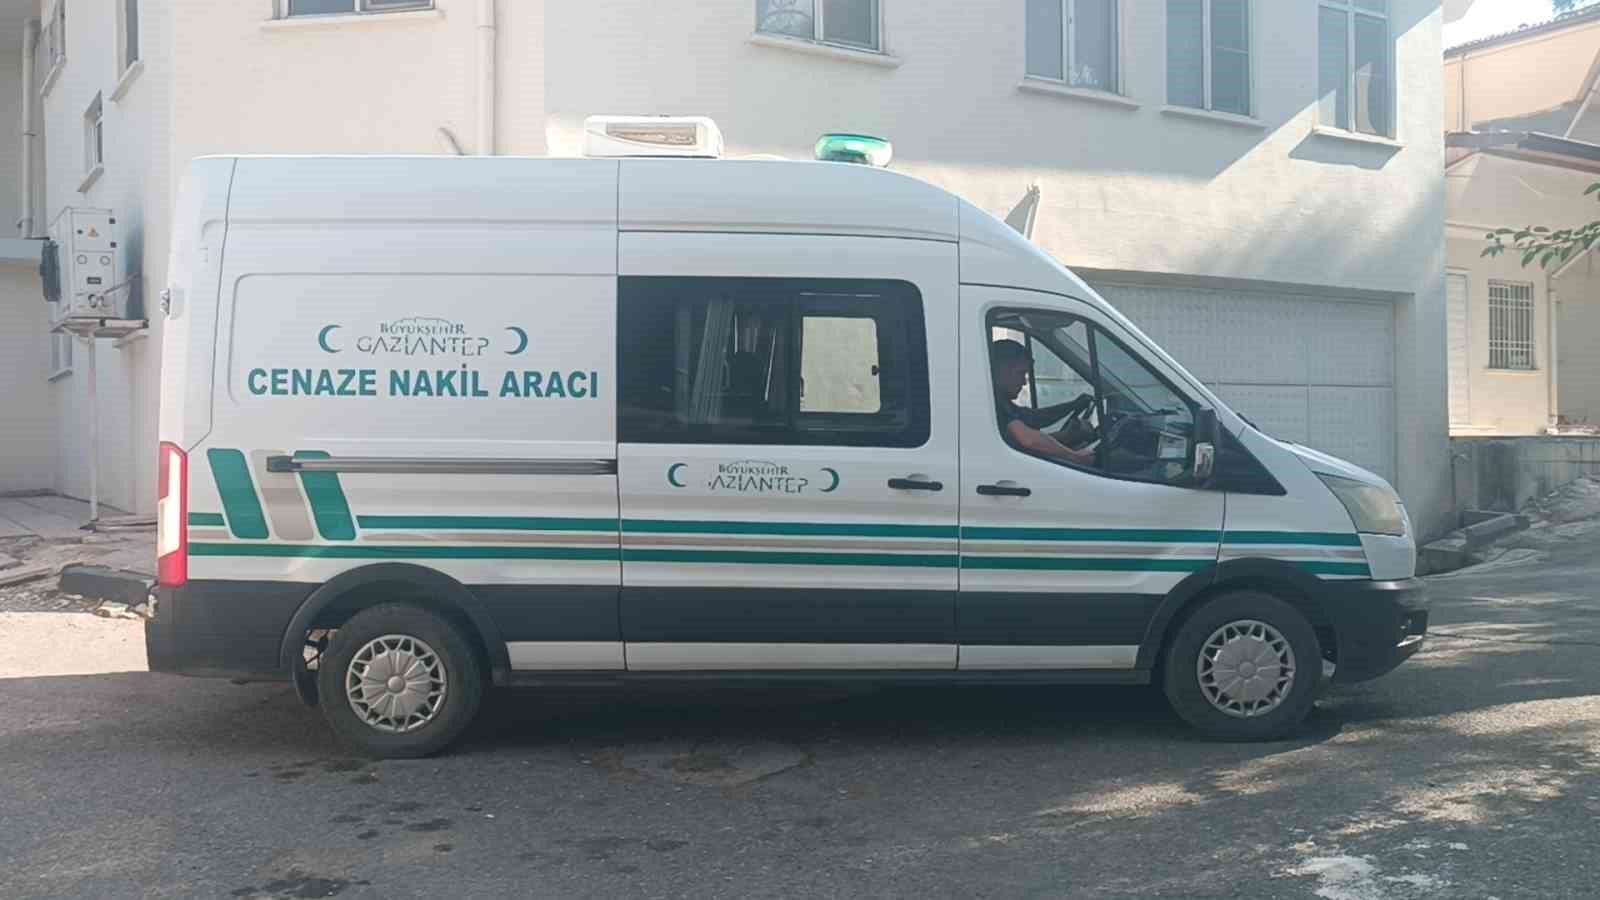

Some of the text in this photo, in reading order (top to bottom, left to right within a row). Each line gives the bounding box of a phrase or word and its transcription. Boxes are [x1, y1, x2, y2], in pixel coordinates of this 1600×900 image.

[247, 363, 599, 399] CENAZE NAKİL ARACI
